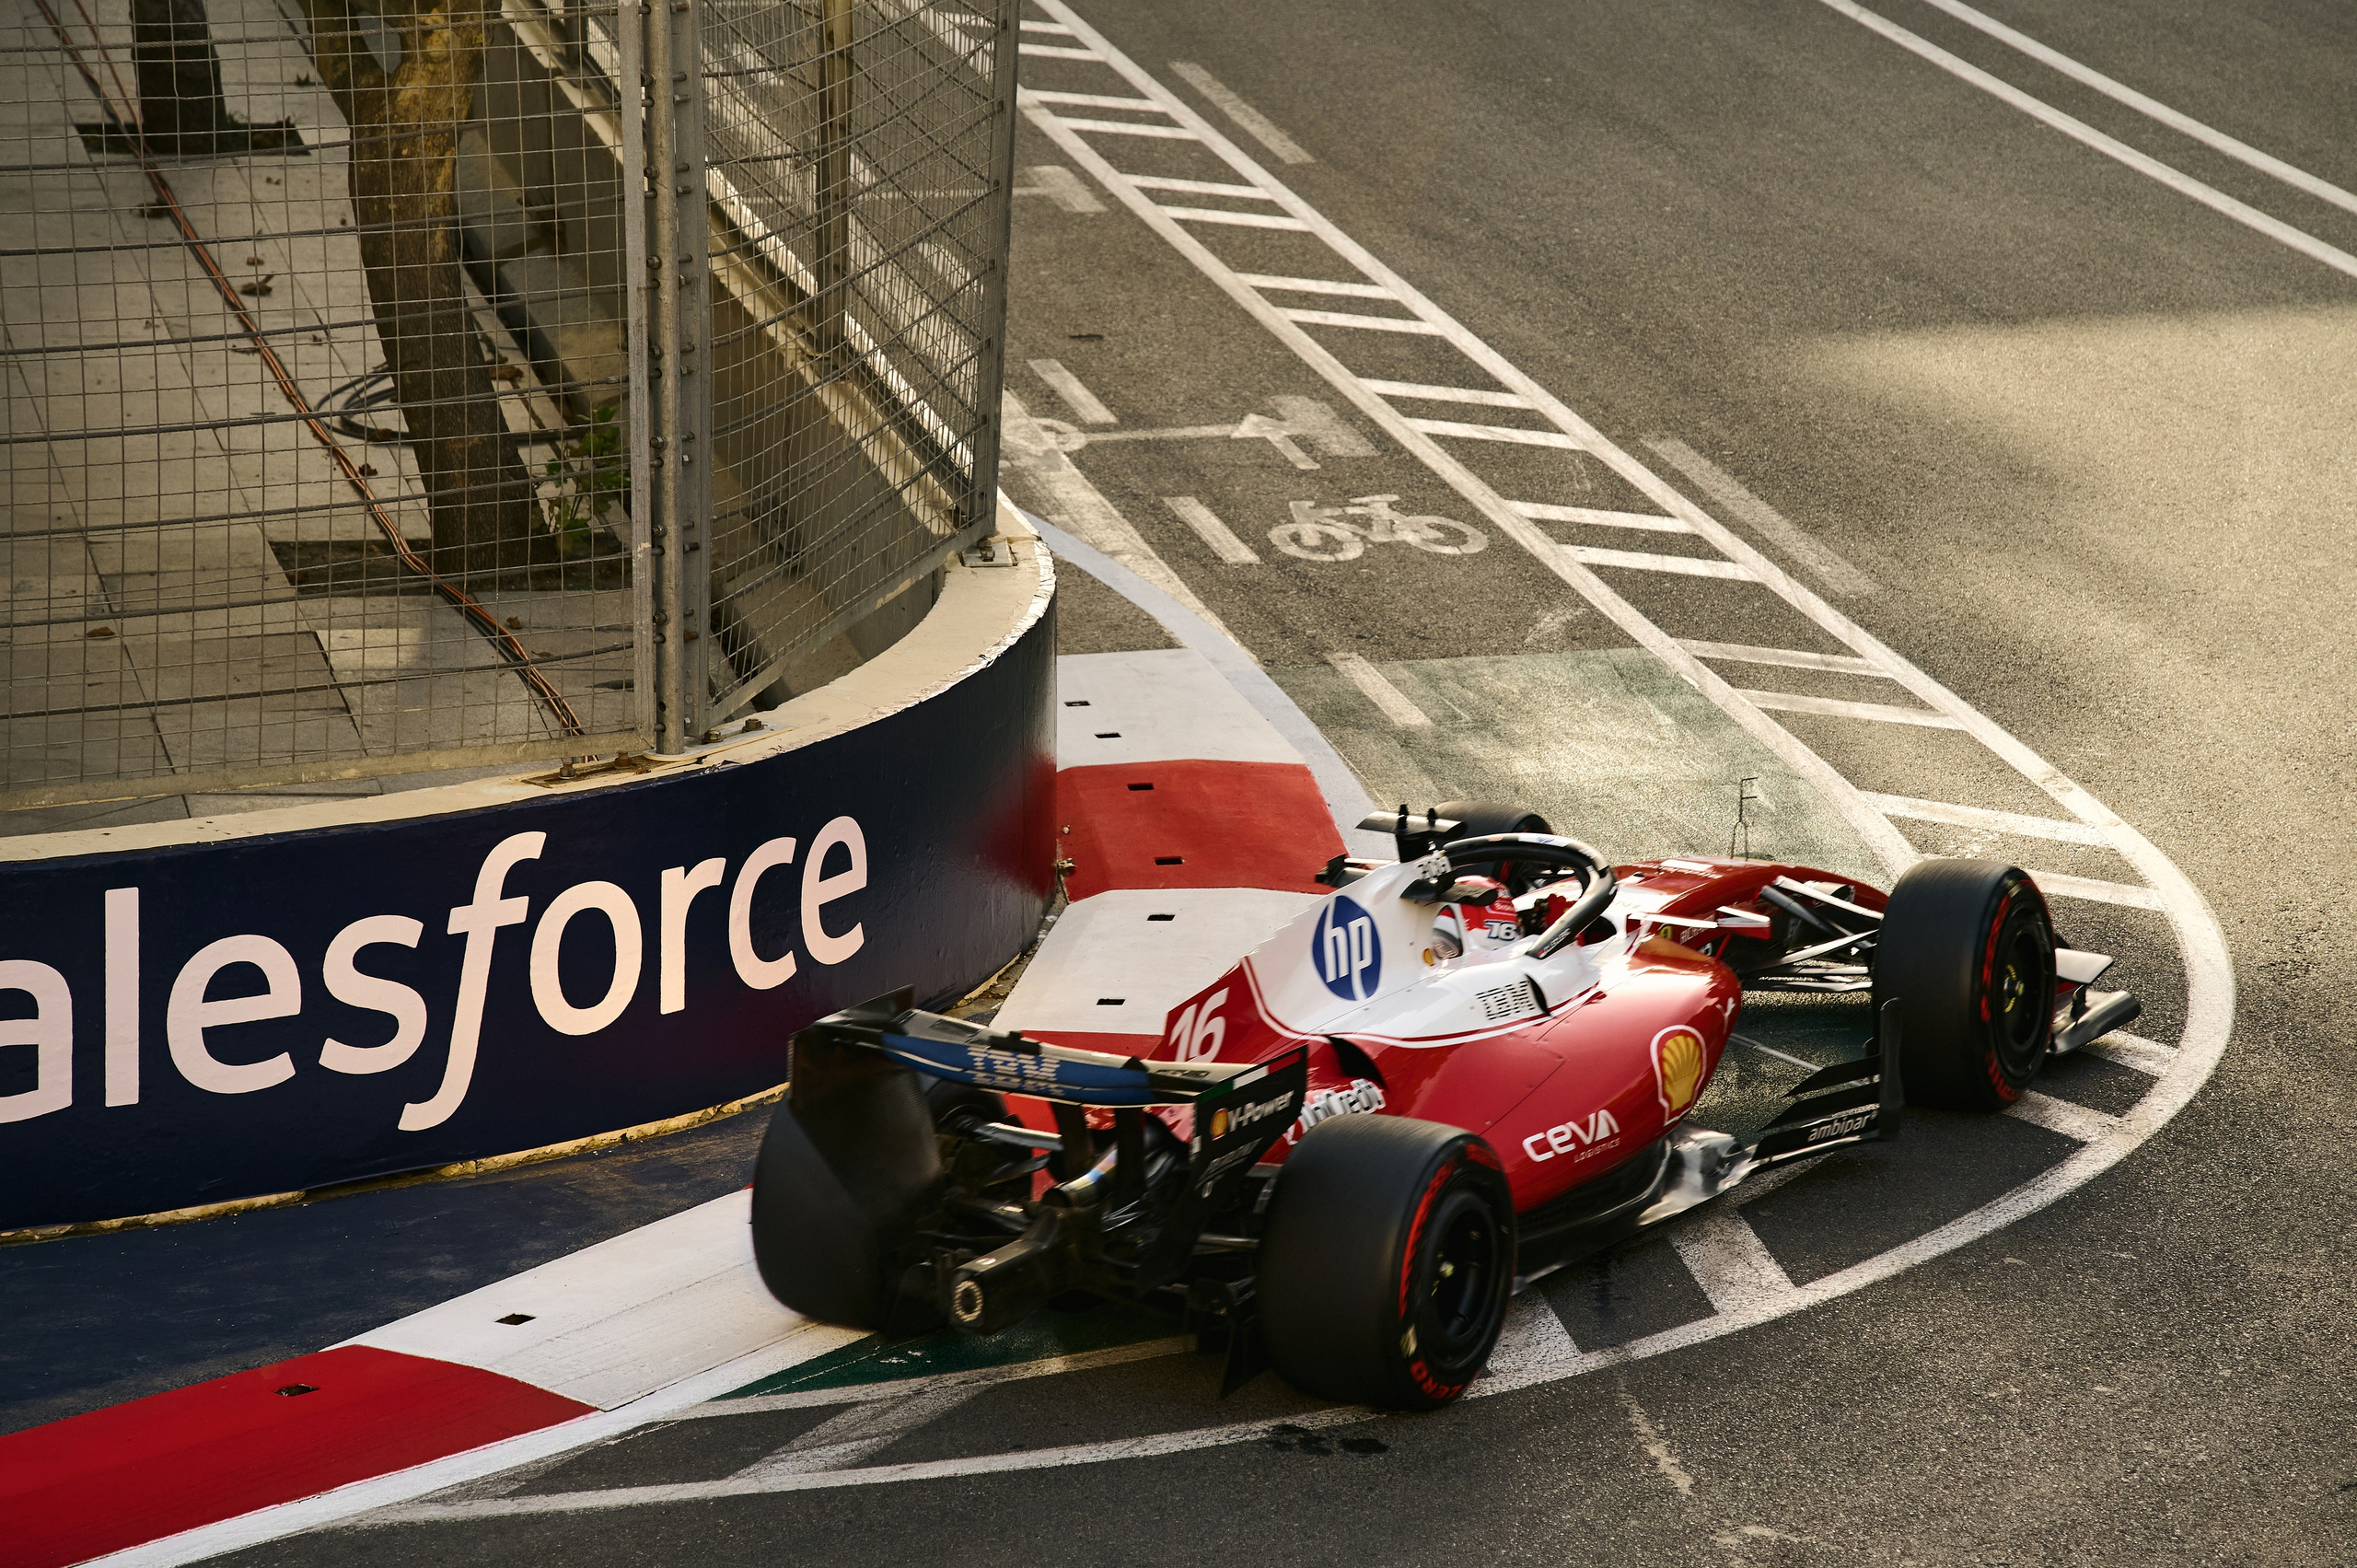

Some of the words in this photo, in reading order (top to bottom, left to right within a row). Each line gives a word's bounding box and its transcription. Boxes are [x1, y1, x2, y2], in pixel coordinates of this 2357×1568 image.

[1322, 899, 1374, 1002] hp
[1483, 920, 1518, 942] 16
[0, 816, 868, 1132] alesforce
[1475, 980, 1536, 1021] IBM
[1167, 986, 1231, 1063] 16
[967, 1045, 1065, 1098] IBM
[1807, 1112, 1872, 1143] ambipar
